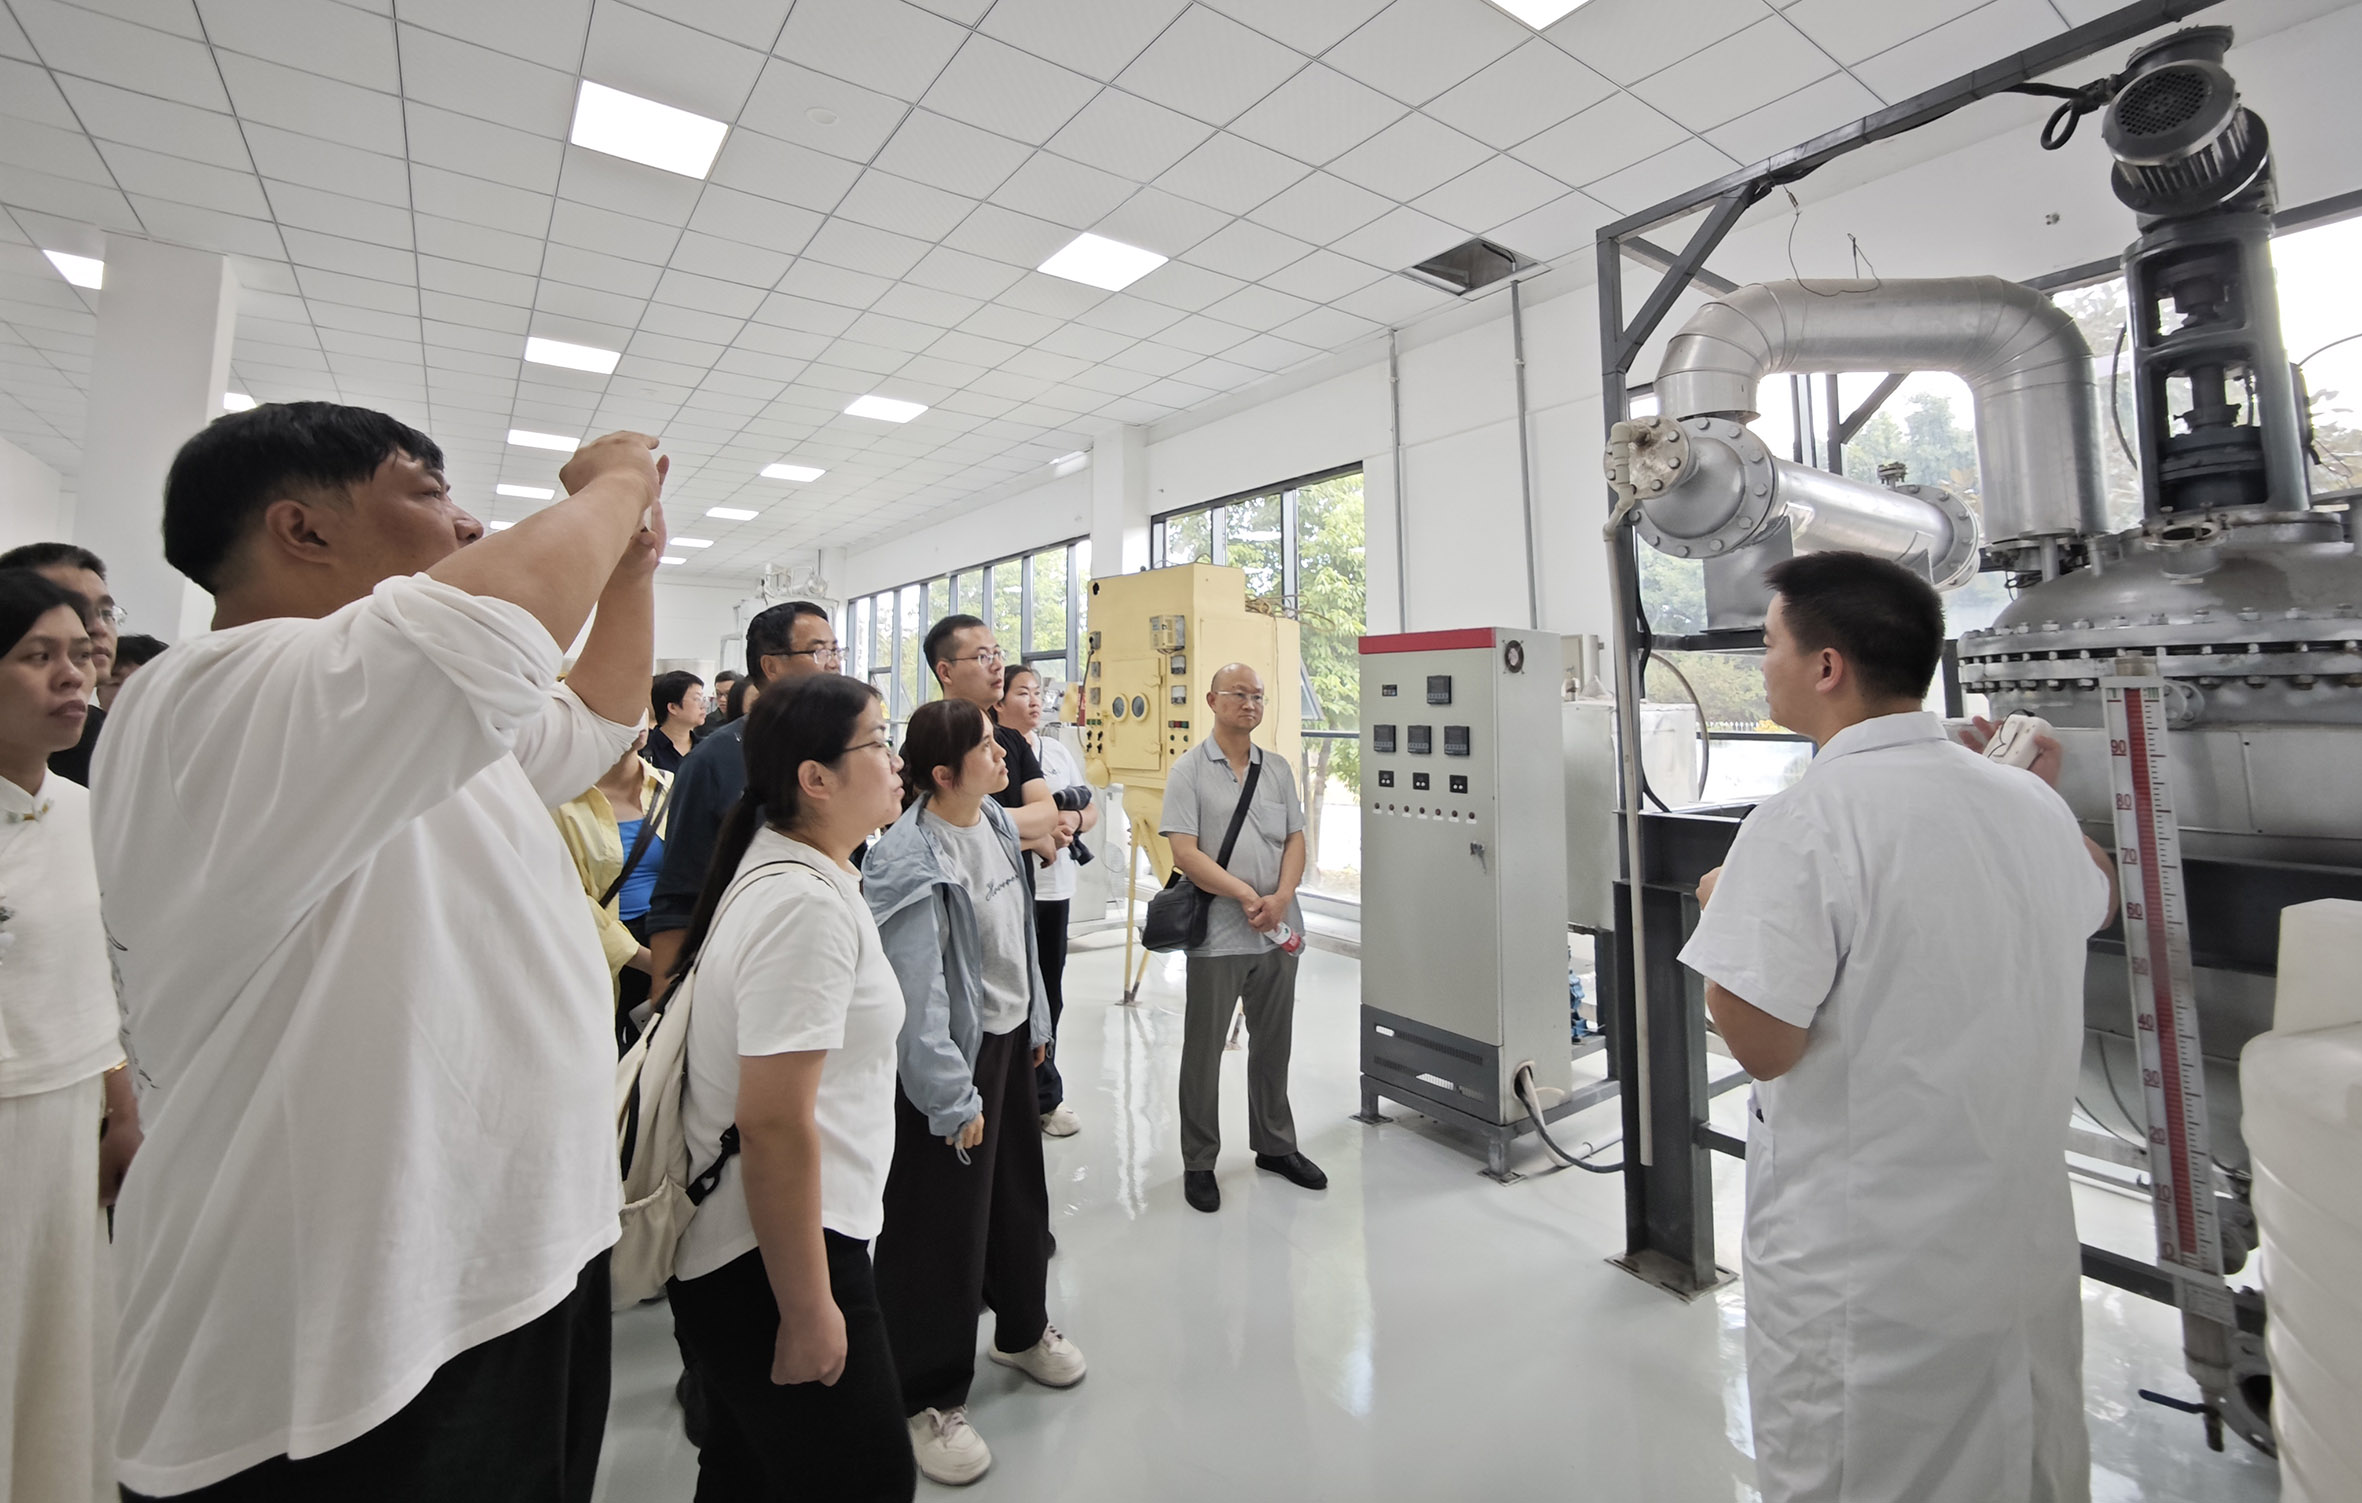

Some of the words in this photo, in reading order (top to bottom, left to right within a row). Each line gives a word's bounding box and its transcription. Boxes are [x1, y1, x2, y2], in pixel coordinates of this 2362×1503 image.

[2111, 739, 2127, 753] 90
[2116, 793, 2132, 808] 80
[2120, 847, 2138, 862] 70
[2126, 902, 2142, 917] 60
[2138, 1013, 2154, 1030] 40
[2143, 1068, 2160, 1086] 30
[2149, 1126, 2166, 1143] 20
[2155, 1183, 2172, 1201] 10
